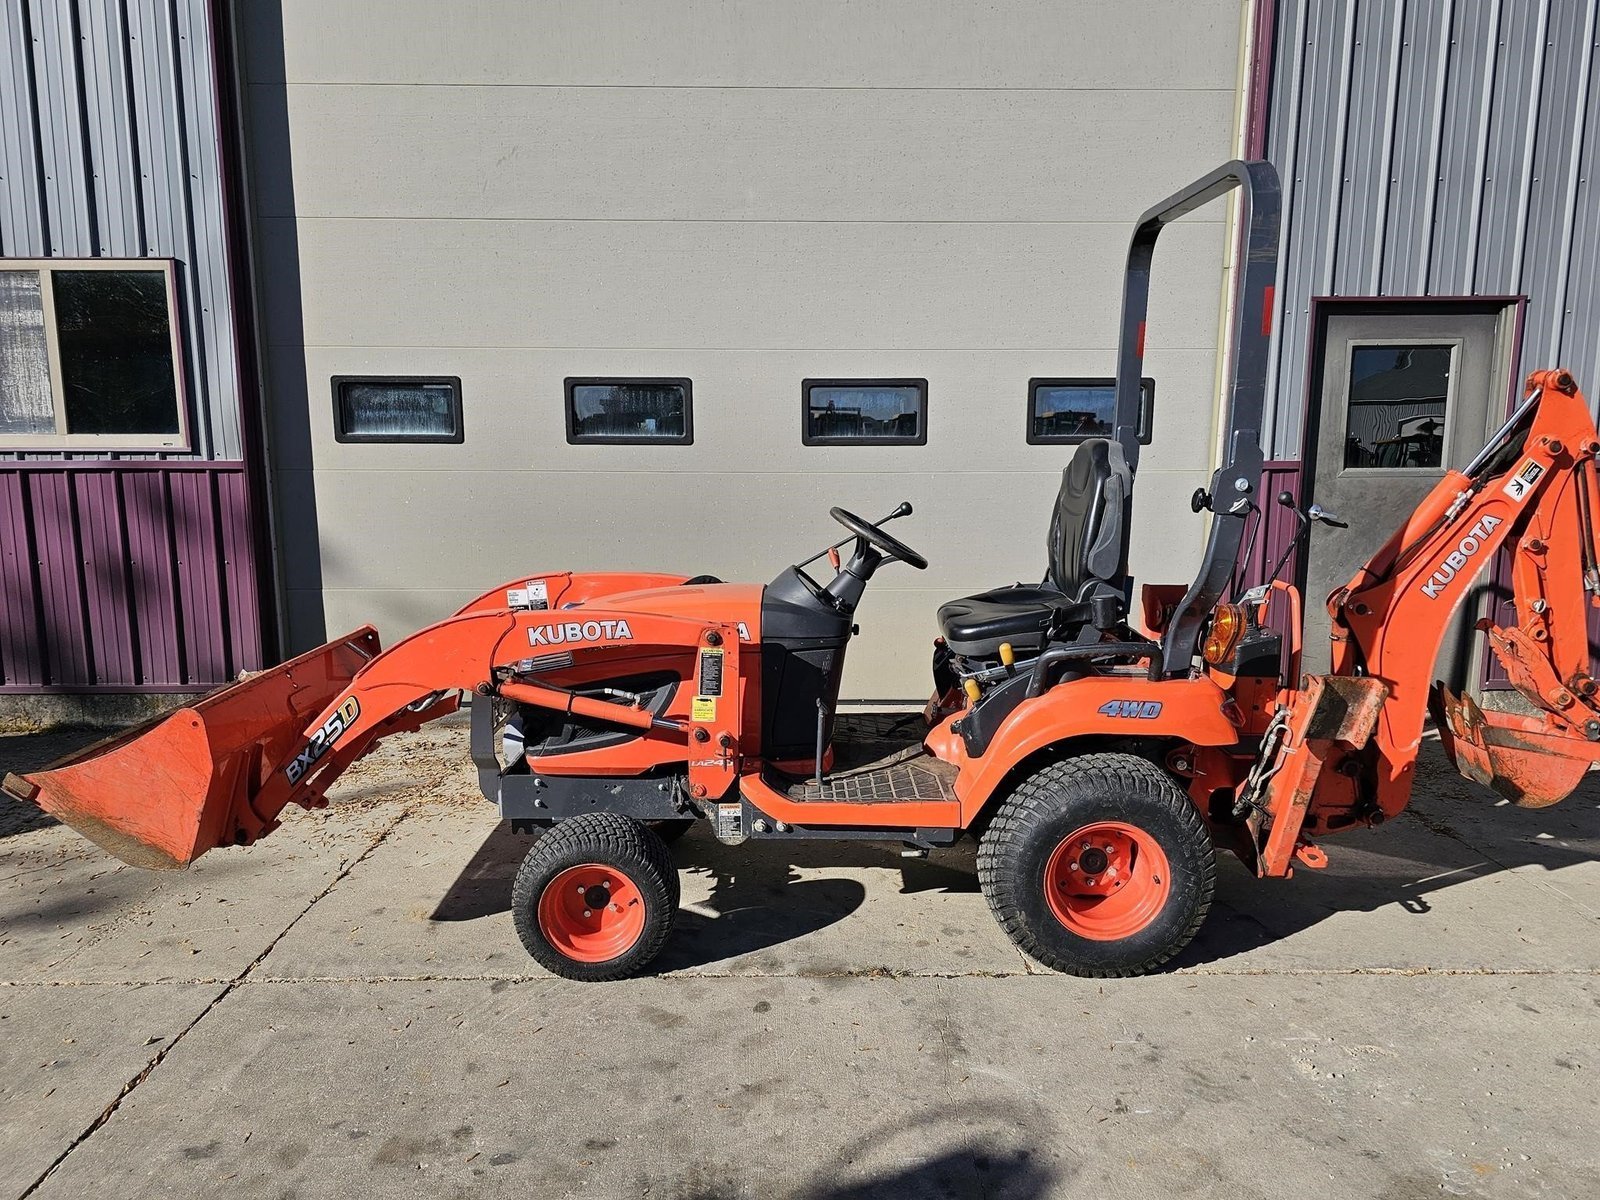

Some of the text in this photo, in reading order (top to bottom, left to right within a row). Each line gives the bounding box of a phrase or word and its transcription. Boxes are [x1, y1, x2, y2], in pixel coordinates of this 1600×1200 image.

[1420, 514, 1503, 600] KUBOTA
[527, 619, 633, 647] KUBOTA
[1097, 699, 1163, 719] 4WD
[285, 695, 361, 787] BX25D
